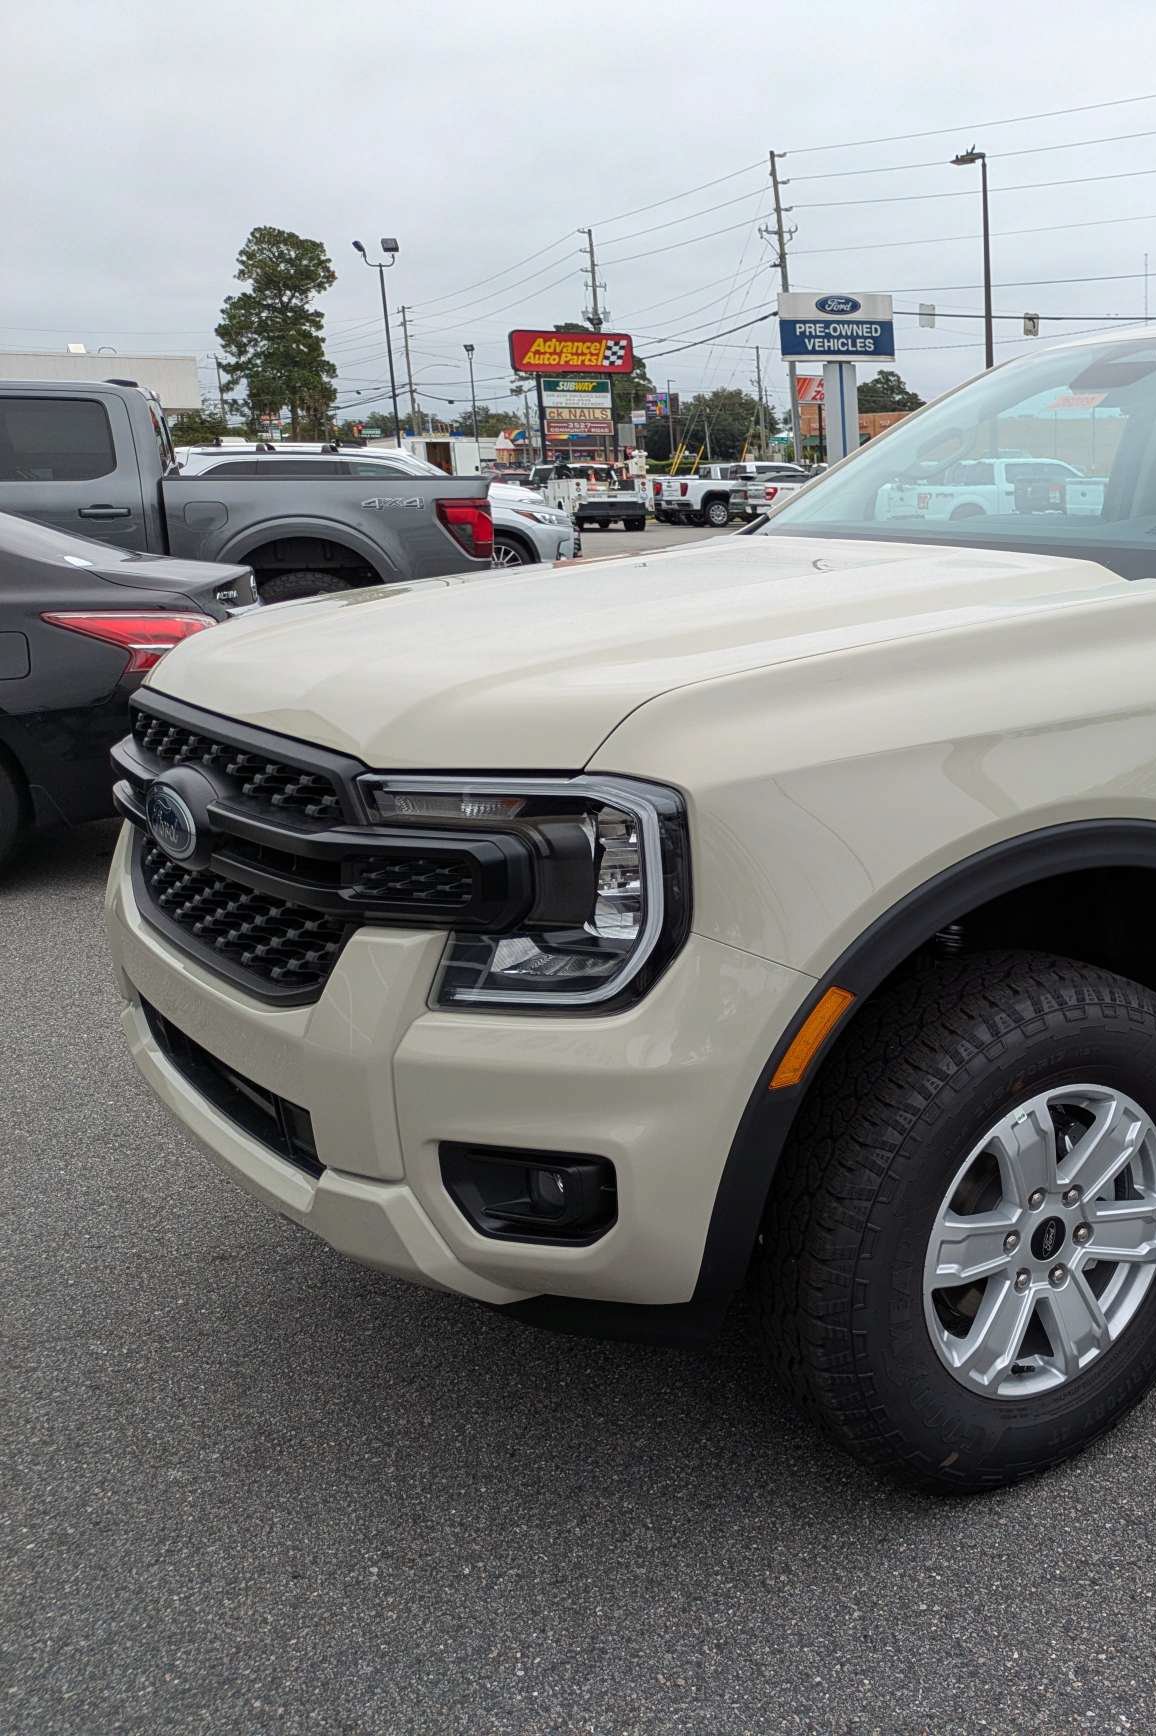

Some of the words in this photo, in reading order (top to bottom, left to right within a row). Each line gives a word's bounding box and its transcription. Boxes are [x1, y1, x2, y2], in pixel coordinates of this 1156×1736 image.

[825, 298, 853, 312] Ford
[795, 323, 881, 337] PRE-OWNED
[530, 337, 601, 354] Advance
[805, 338, 875, 352] VEHICLES
[522, 351, 560, 365] Auto
[560, 353, 600, 366] Parts
[556, 381, 598, 391] SUBWAY
[568, 408, 609, 419] NAILS
